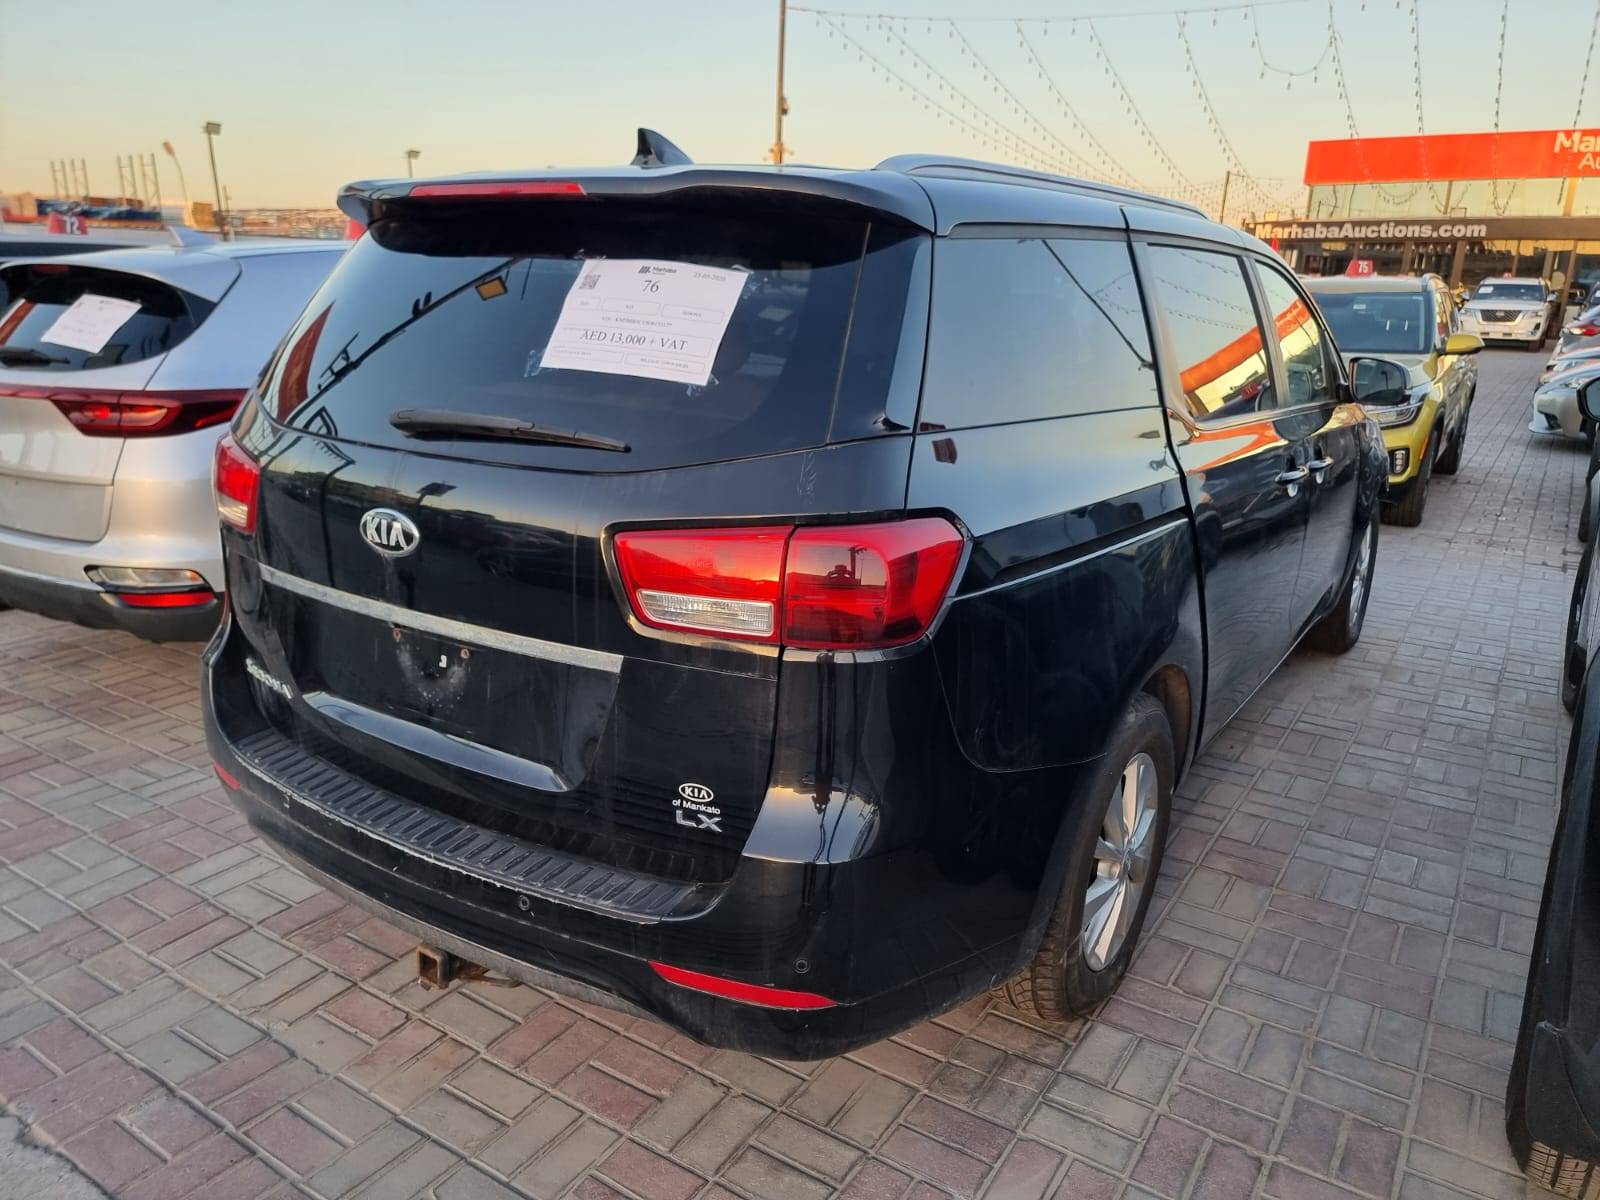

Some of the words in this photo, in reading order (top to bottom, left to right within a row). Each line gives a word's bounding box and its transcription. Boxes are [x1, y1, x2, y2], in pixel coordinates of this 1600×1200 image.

[1254, 221, 1487, 239] MarhabaAuctions.com
[1358, 261, 1368, 273] 75
[643, 279, 660, 293] 76
[580, 329, 607, 342] AED
[610, 333, 646, 345] 13,000
[660, 337, 688, 350] VAT
[366, 515, 408, 550] KIA
[684, 786, 709, 799] KIA
[672, 799, 681, 807] of
[683, 800, 721, 814] Mankato
[676, 810, 723, 833] LX
